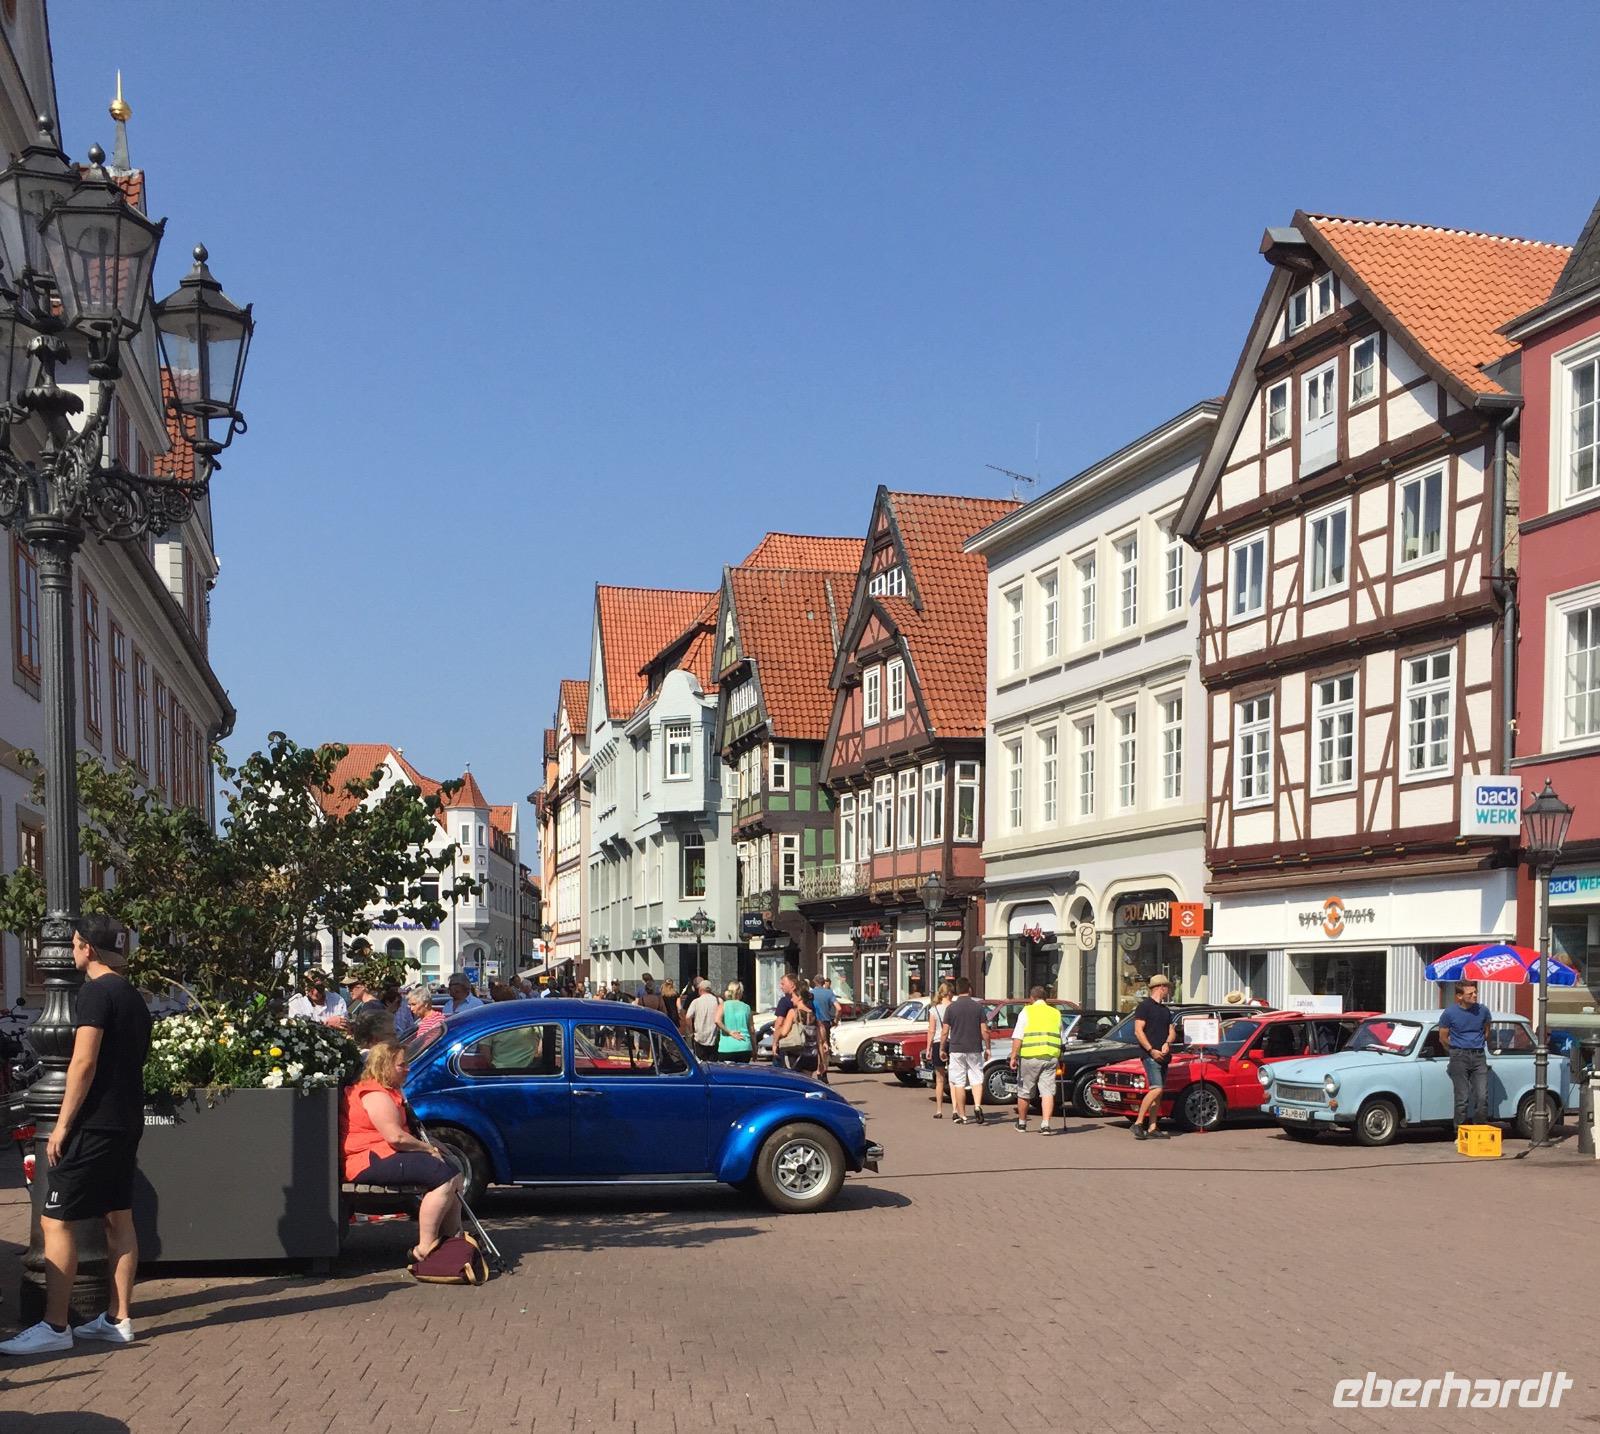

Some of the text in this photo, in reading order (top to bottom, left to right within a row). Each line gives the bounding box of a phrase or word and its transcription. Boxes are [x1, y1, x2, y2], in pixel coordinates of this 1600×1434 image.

[1478, 787, 1516, 804] back
[1475, 808, 1517, 824] WERK
[744, 917, 762, 925] arko
